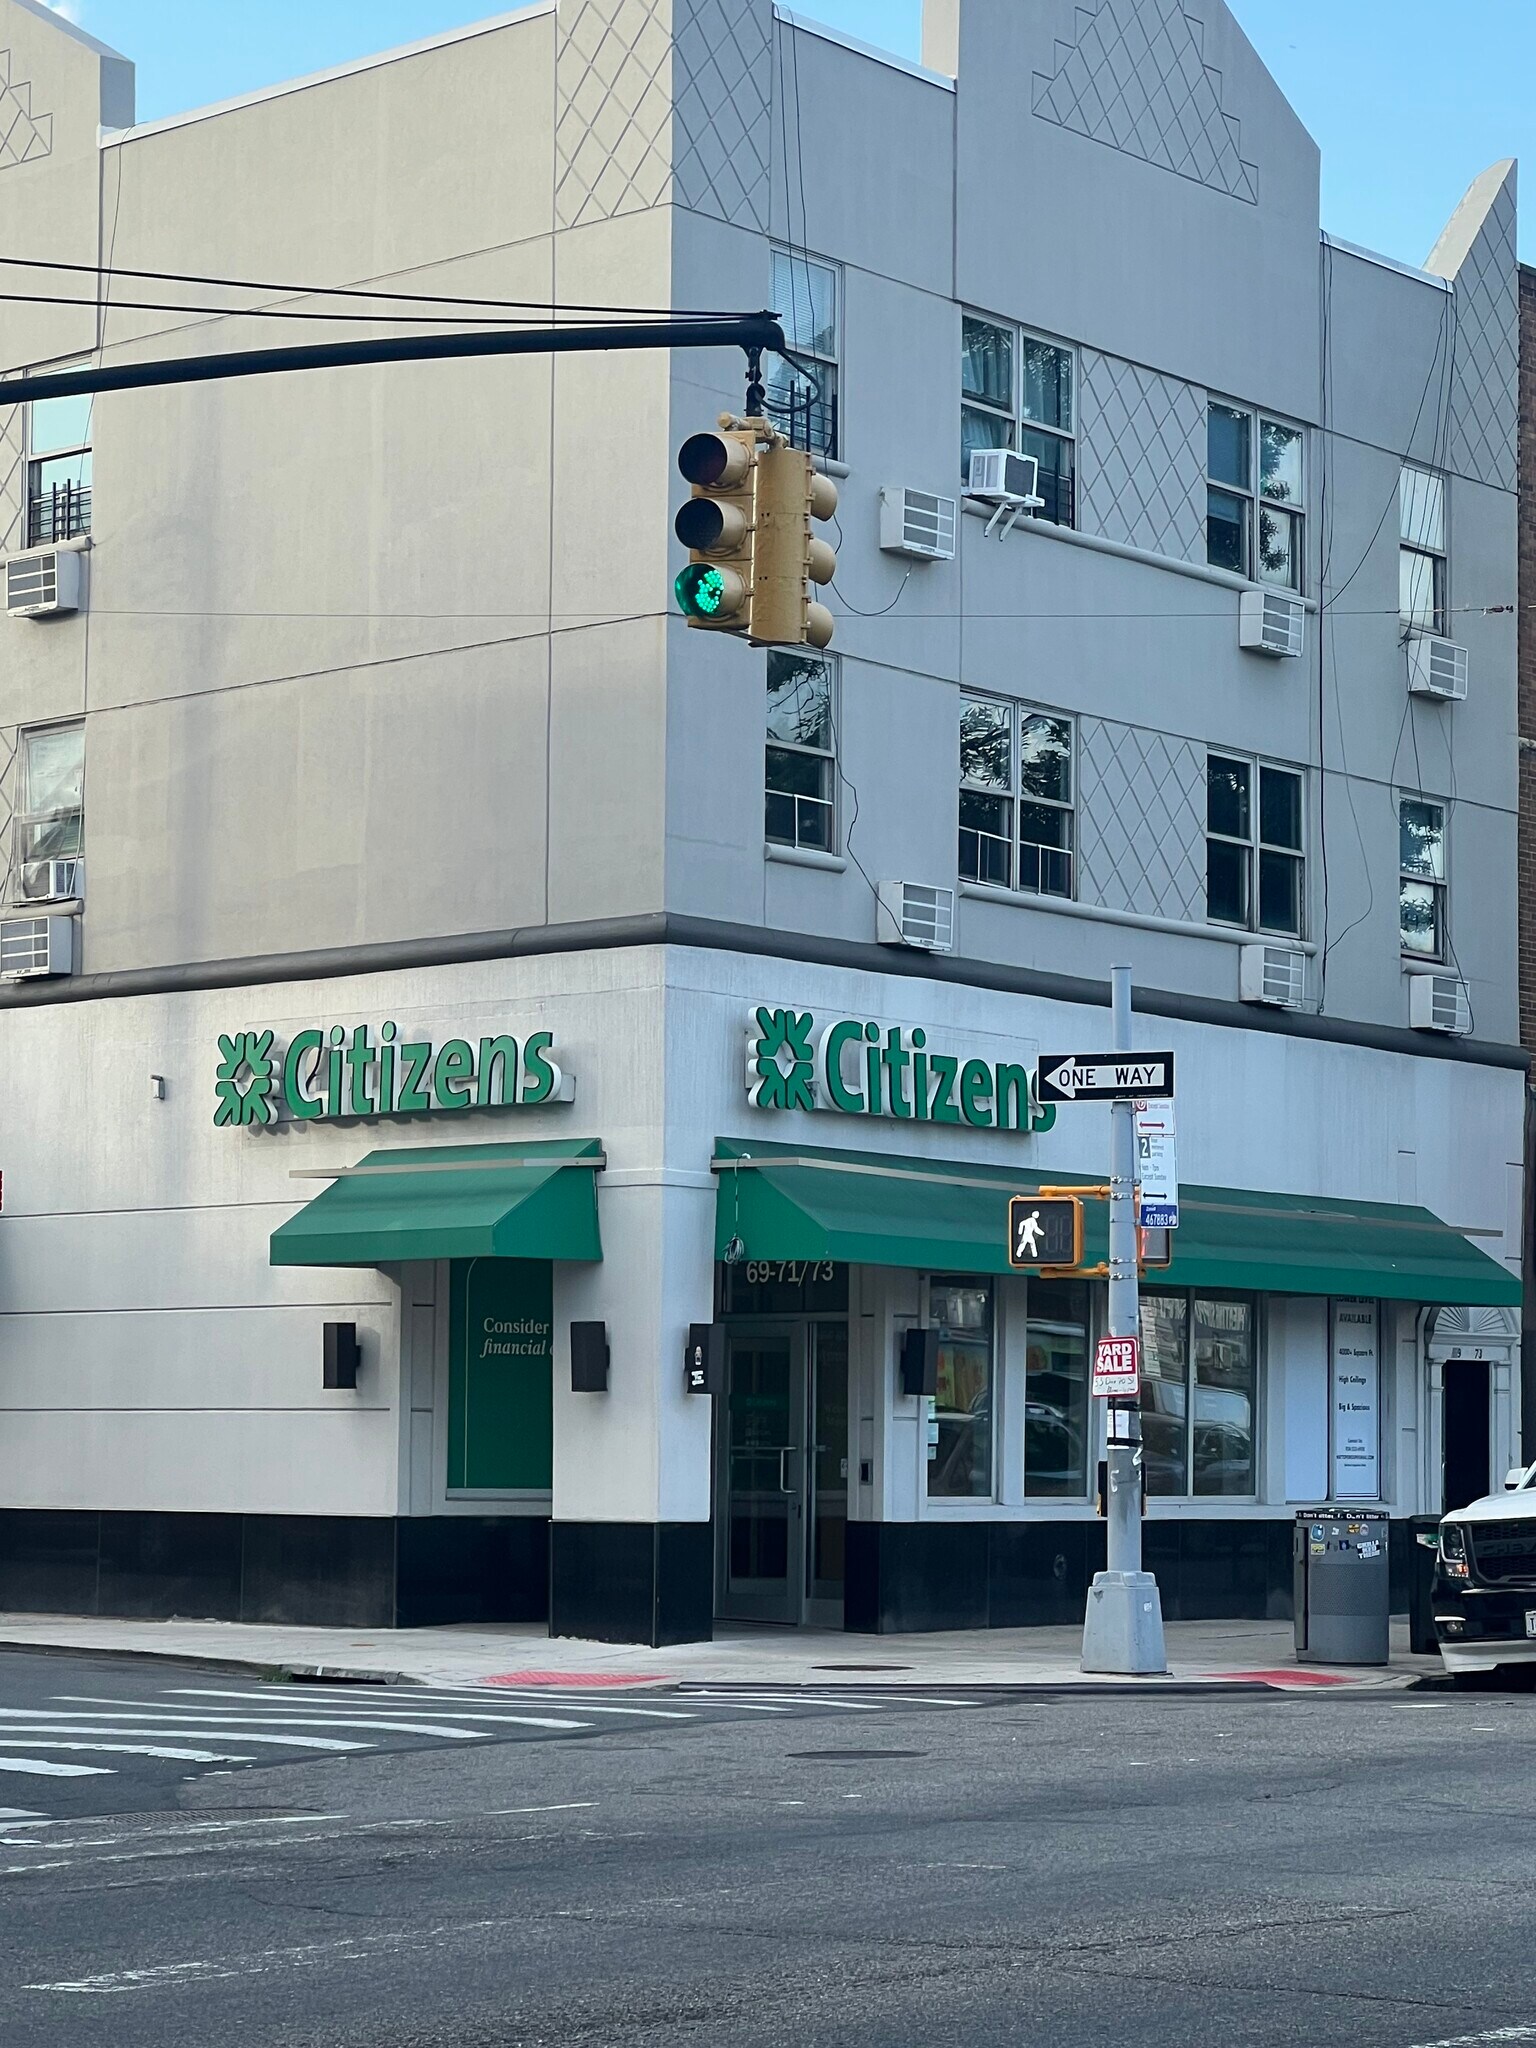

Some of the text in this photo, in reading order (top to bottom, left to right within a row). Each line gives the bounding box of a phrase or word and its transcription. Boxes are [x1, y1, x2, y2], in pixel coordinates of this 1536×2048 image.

[284, 1020, 556, 1119] Citizens
[1058, 1066, 1156, 1087] ONE WAY
[1141, 1138, 1149, 1157] 2
[1145, 1213, 1168, 1226] 467883
[483, 1317, 550, 1335] Consider
[1339, 1313, 1372, 1324] AVAILABLE
[479, 1338, 547, 1358] financial
[1098, 1342, 1132, 1357] YARD
[1474, 1348, 1482, 1359] 73
[1096, 1355, 1133, 1373] SALE
[1339, 1375, 1349, 1385] High
[1338, 1402, 1346, 1412] Big
